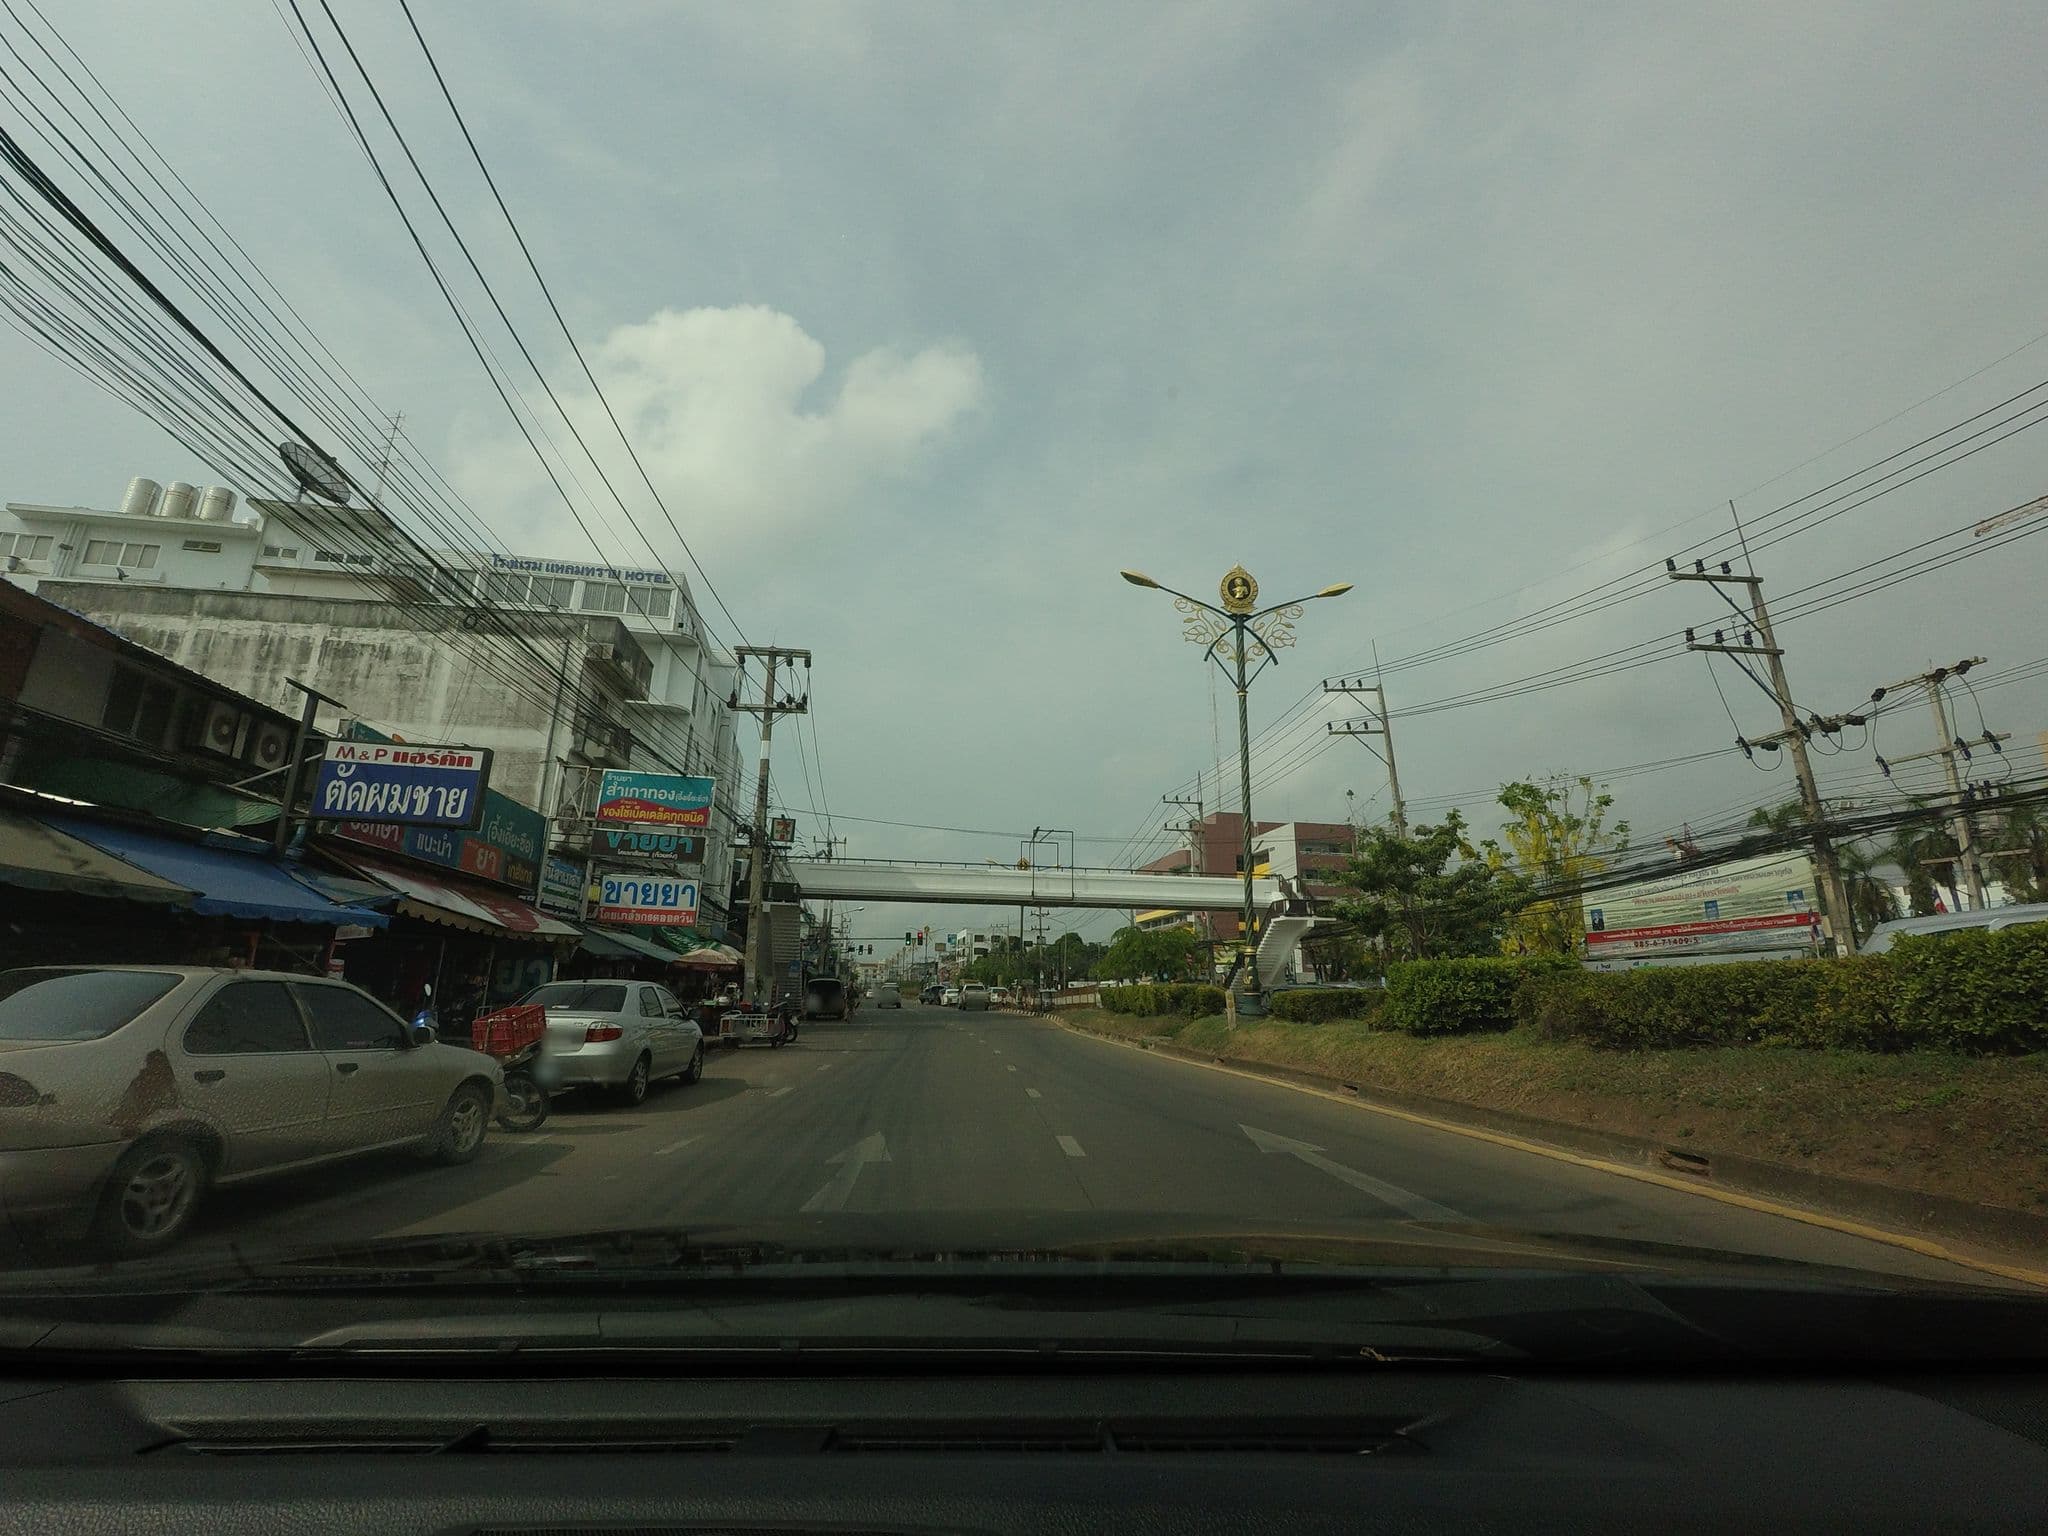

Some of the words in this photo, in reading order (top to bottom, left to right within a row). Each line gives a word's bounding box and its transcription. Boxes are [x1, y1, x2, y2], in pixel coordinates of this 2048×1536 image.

[624, 570, 671, 584] HOTEL
[335, 746, 355, 760] M
[359, 750, 370, 761] &
[374, 748, 388, 761] P
[324, 763, 469, 819] ตัดผมชาย
[606, 781, 676, 801] สำเภาทอง
[416, 832, 453, 859] แนะนำ
[606, 831, 694, 854] ขายยา
[476, 848, 497, 874] ยา
[604, 880, 696, 907] ขายยา
